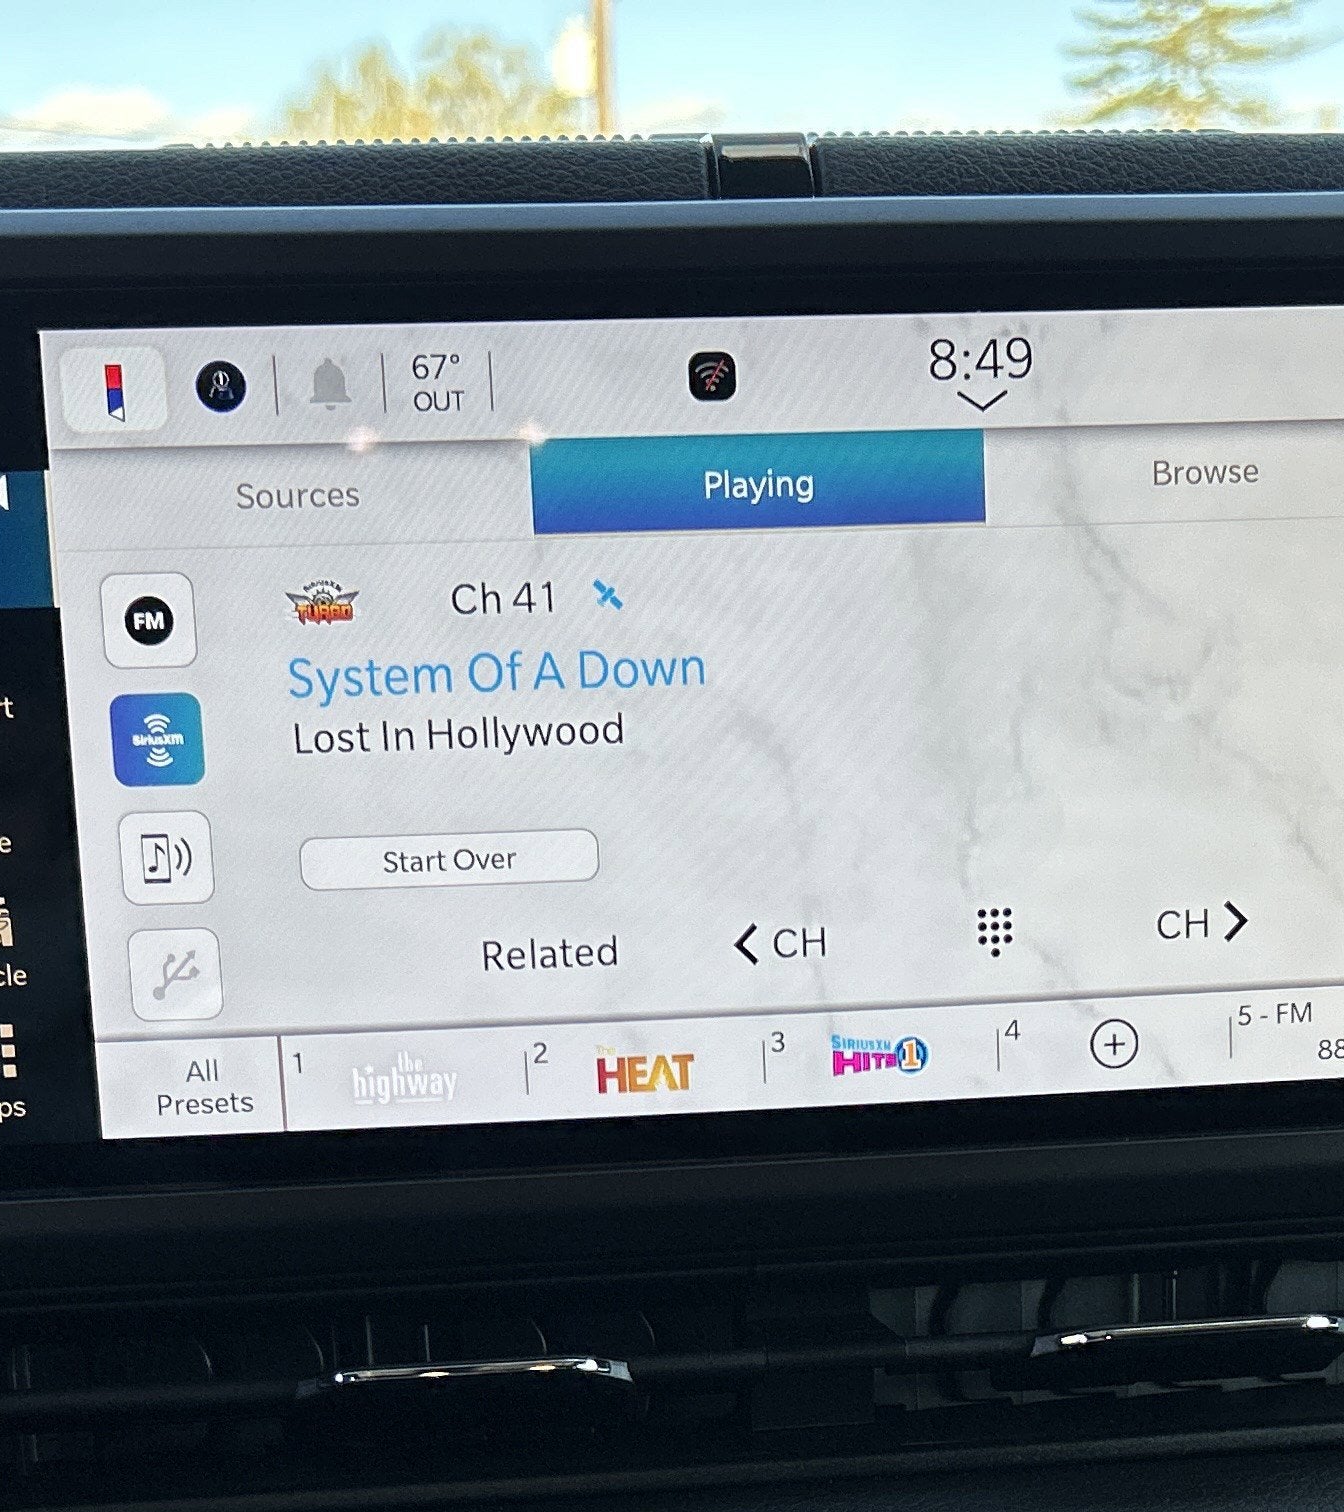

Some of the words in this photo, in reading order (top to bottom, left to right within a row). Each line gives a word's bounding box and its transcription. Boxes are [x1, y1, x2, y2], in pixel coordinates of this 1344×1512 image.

[929, 337, 1032, 380] 8:49
[414, 390, 465, 413] OUT
[704, 469, 814, 505] Playing
[1153, 459, 1259, 486] Browse
[236, 482, 359, 511] Sources
[451, 581, 501, 615] Ch
[513, 581, 555, 613] 41
[133, 611, 164, 630] FM
[289, 657, 452, 706] System
[469, 650, 523, 692] Of
[534, 650, 565, 691] A
[580, 650, 706, 689] Down
[294, 721, 370, 754] Lost
[382, 720, 414, 751] In
[428, 712, 623, 755] Hollywood
[383, 849, 446, 873] Start
[453, 848, 516, 871] Over
[1157, 910, 1209, 941] CH
[483, 936, 618, 971] Related
[773, 928, 826, 957] CH
[1238, 1006, 1252, 1026] 5
[1277, 1003, 1314, 1025] FM
[770, 1032, 785, 1054] 3
[1004, 1019, 1021, 1041] 4
[292, 1053, 303, 1074] 1
[533, 1043, 549, 1065] 2
[833, 1050, 897, 1077] HITS
[902, 1039, 922, 1069] 1
[186, 1060, 219, 1083] All
[353, 1064, 457, 1104] highway
[597, 1053, 694, 1094] HEAT
[157, 1092, 253, 1118] Presets
